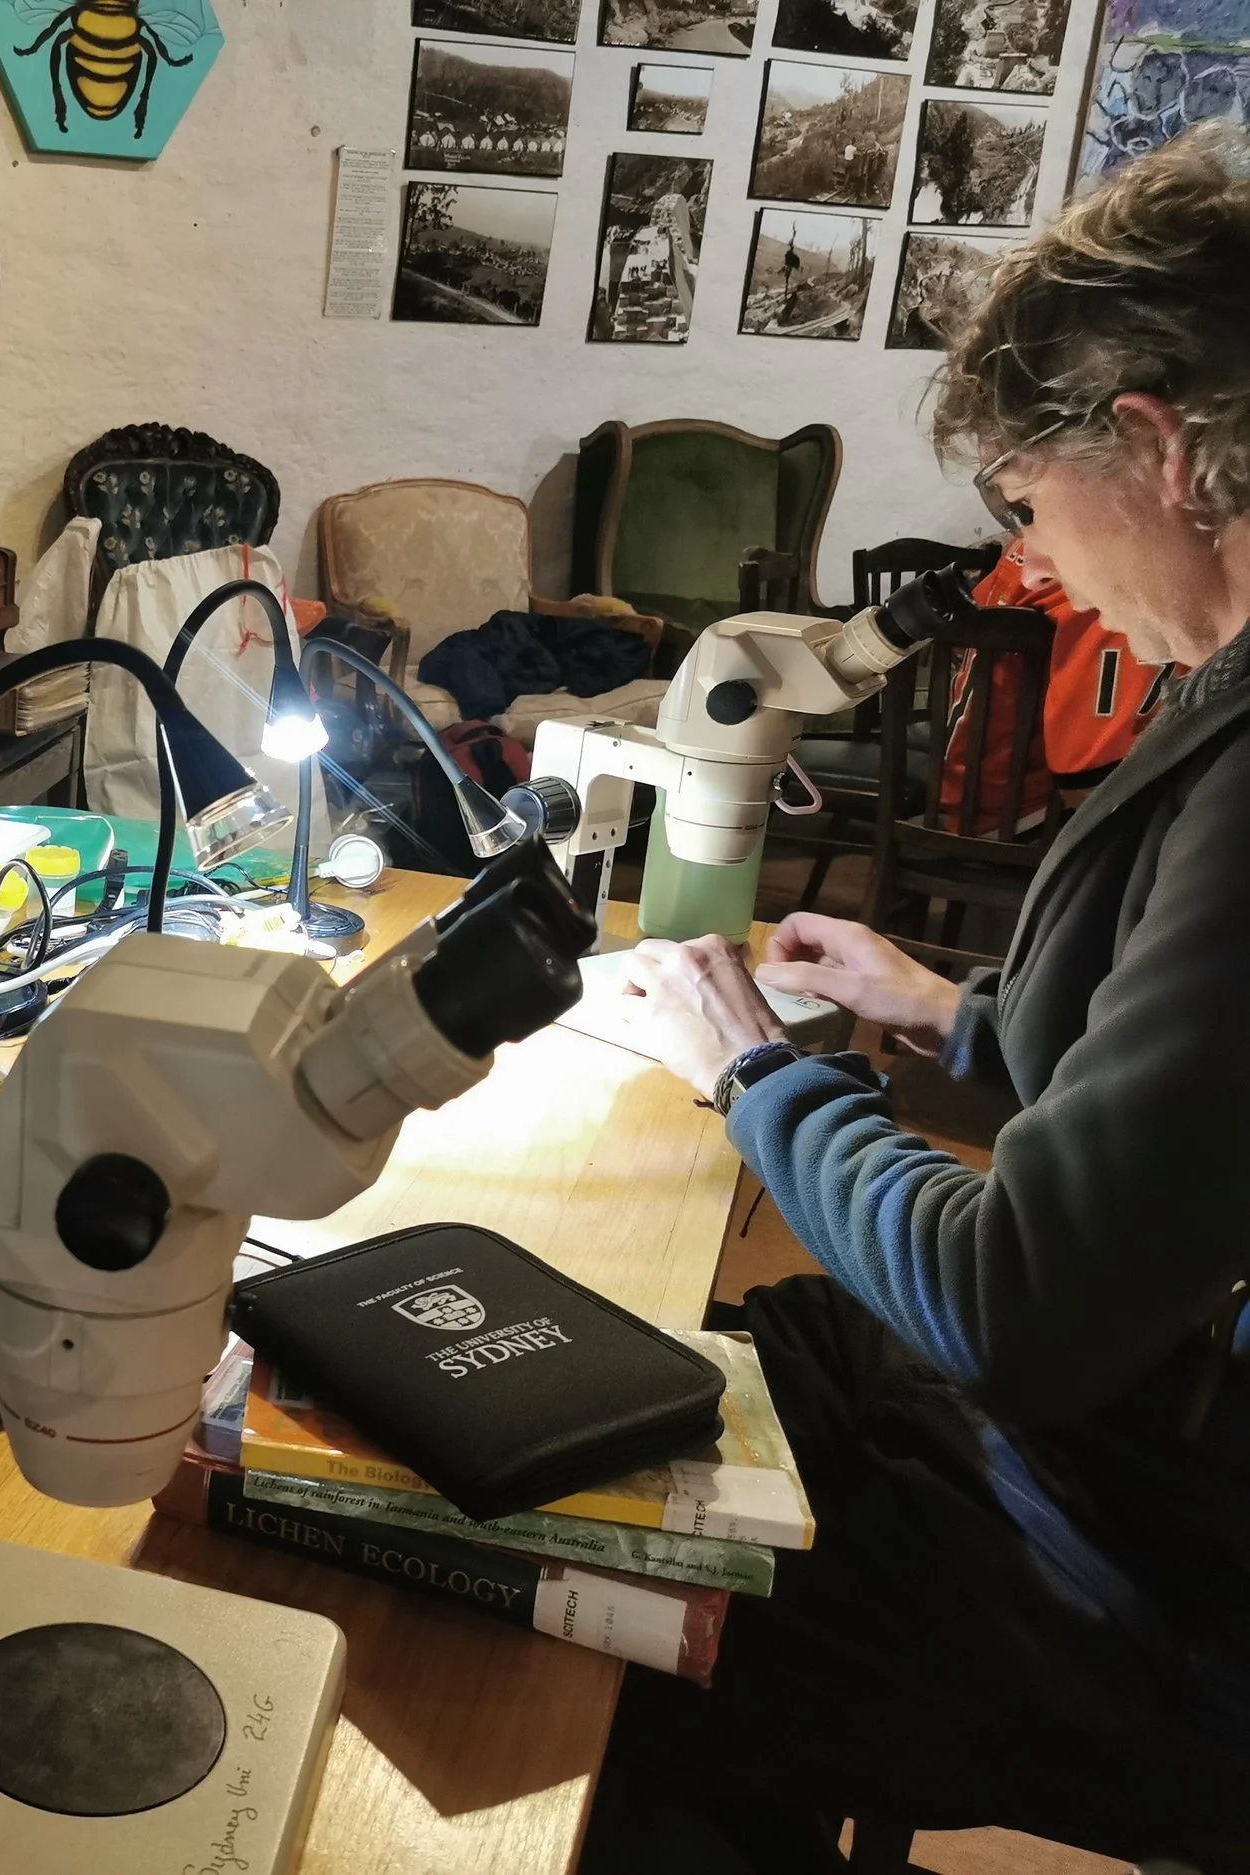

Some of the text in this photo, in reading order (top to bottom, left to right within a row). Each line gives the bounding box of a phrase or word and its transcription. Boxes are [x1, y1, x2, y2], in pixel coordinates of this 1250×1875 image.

[356, 1266, 464, 1308] THE FACULTY OF SCIENCE
[425, 1315, 554, 1363] THE UNIVERSITY OF
[438, 1324, 574, 1379] SYDNEY
[326, 1460, 359, 1477] The
[253, 1476, 607, 1552] Lichens of rainforest in Tasmania and south-eastern Australia
[692, 1499, 707, 1536] CITECH
[224, 1502, 521, 1610] LICHEN ECOLOGY
[685, 1561, 703, 1571] and
[562, 1589, 580, 1639] SCITECH
[225, 1766, 252, 1797] Uni
